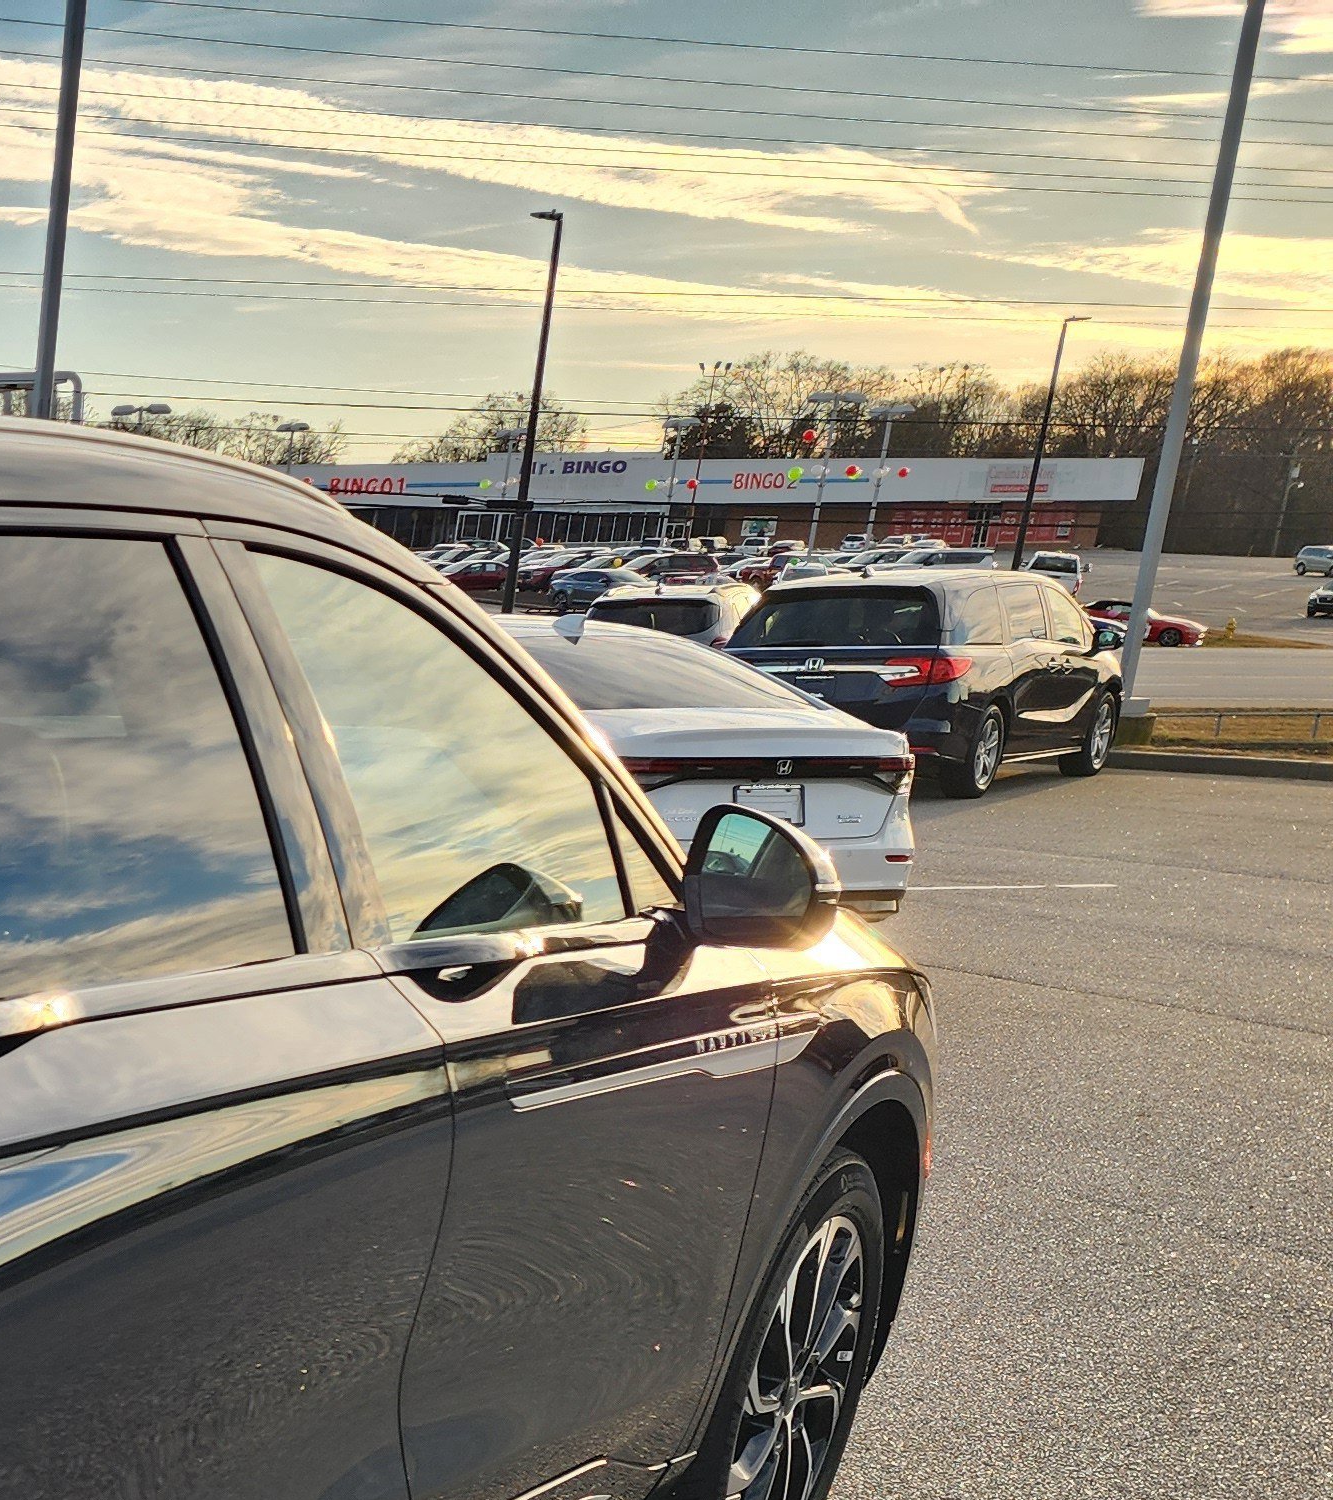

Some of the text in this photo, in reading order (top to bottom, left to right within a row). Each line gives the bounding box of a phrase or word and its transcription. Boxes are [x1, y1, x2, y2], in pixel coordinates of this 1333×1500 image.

[562, 460, 627, 474] BINGO
[329, 477, 393, 495] BINGO
[734, 472, 785, 489] BINGO
